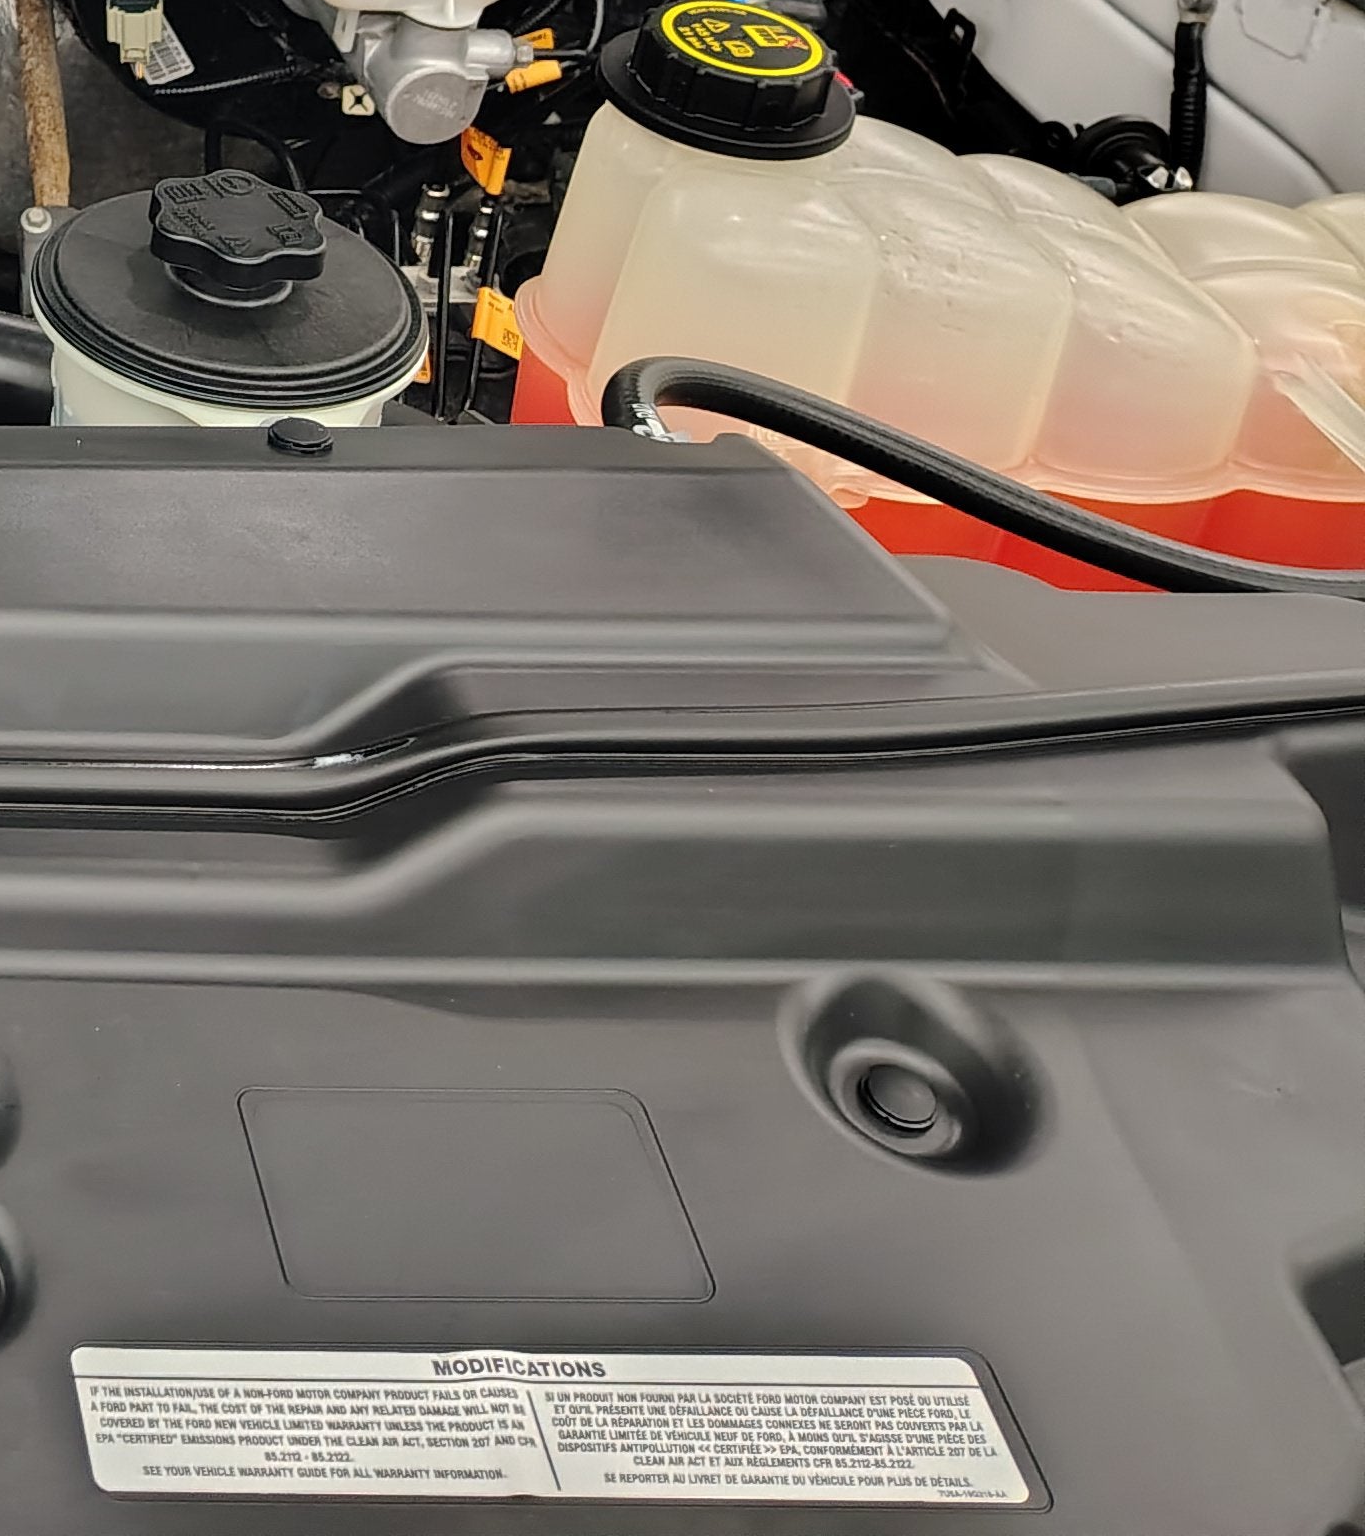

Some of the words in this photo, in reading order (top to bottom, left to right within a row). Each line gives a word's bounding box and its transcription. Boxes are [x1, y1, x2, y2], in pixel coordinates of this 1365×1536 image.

[432, 1358, 607, 1378] MODIFICATIONS
[102, 1385, 122, 1397] THE
[123, 1386, 215, 1398] INSTALLATION/USE
[242, 1388, 293, 1398] NON-FORD
[295, 1388, 331, 1399] MOTOR
[333, 1389, 381, 1400] COMPANY
[383, 1389, 429, 1400] PRODUCT
[432, 1390, 460, 1400] FAILS
[480, 1387, 518, 1398] CAUSES
[557, 1392, 570, 1402] UN
[573, 1392, 613, 1402] PRODUIT
[617, 1392, 637, 1402] NON
[639, 1392, 675, 1402] FOURNI
[677, 1393, 696, 1403] PAR
[698, 1393, 711, 1403] LA
[713, 1393, 753, 1404] SOCIÉTÉ
[756, 1393, 781, 1404] FORD
[784, 1394, 818, 1404] MOTOR
[820, 1395, 866, 1404] COMPANY
[869, 1395, 887, 1405] EST
[890, 1395, 915, 1405] POSÉ
[917, 1395, 931, 1406] OU
[933, 1396, 969, 1406] UTILISÉ
[99, 1401, 127, 1412] FORD
[129, 1402, 154, 1412] PART
[200, 1402, 219, 1414] THE
[221, 1403, 247, 1414] COST
[249, 1403, 263, 1414] OF
[266, 1403, 285, 1414] THE
[287, 1404, 323, 1414] REPAIR
[325, 1405, 347, 1414] AND
[349, 1405, 369, 1415] ANY
[372, 1404, 416, 1416] RELATED
[418, 1405, 461, 1416] DAMAGE
[463, 1405, 488, 1415] WILL
[490, 1403, 510, 1414] NOT
[553, 1406, 566, 1414] ET
[595, 1406, 645, 1415] PRÉSENTE
[647, 1406, 666, 1415] UNE
[669, 1406, 733, 1416] DÉFAILLANCE
[735, 1407, 748, 1416] OU
[751, 1407, 782, 1416] CAUSE
[784, 1407, 798, 1416] LA
[800, 1408, 864, 1417] DÉFAILLANCE
[898, 1409, 925, 1418] PIÈCE
[928, 1409, 956, 1418] FORD,
[99, 1417, 145, 1428] COVERED
[147, 1418, 160, 1428] BY
[163, 1418, 183, 1429] THE
[185, 1418, 212, 1429] FORD
[214, 1419, 237, 1429] NEW
[239, 1419, 280, 1430] VEHICLE
[283, 1419, 323, 1430] LIMITED
[326, 1420, 382, 1430] WARRANTY
[384, 1420, 423, 1431] UNLESS
[426, 1421, 446, 1432] THE
[447, 1420, 495, 1432] PRODUCT
[511, 1420, 525, 1430] AN
[551, 1417, 577, 1427] COÛT
[580, 1417, 593, 1427] DE
[595, 1418, 608, 1427] LA
[610, 1418, 670, 1428] RÉPARATION
[672, 1418, 684, 1428] ET
[687, 1419, 705, 1428] LES
[707, 1419, 763, 1428] DOMMAGES
[765, 1420, 816, 1429] CONNEXES
[818, 1420, 831, 1430] NE
[834, 1420, 871, 1430] SERONT
[874, 1421, 894, 1430] PAS
[896, 1421, 946, 1430] COUVERTS
[948, 1422, 968, 1431] PAR
[969, 1422, 984, 1431] LA
[95, 1433, 115, 1444] EPA
[180, 1434, 235, 1444] EMISSIONS
[238, 1435, 283, 1446] PRODUCT
[287, 1435, 321, 1446] UNDER
[324, 1436, 343, 1446] THE
[346, 1436, 379, 1446] CLEAN
[381, 1437, 399, 1446] AIR
[402, 1436, 424, 1448] ACT,
[426, 1437, 469, 1447] SECTION
[471, 1436, 491, 1448] 207
[494, 1435, 515, 1446] AND
[557, 1430, 607, 1440] GARANTIE
[609, 1430, 647, 1440] LIMITÉE
[650, 1431, 663, 1440] DE
[665, 1431, 711, 1441] VÉHICULE
[713, 1432, 738, 1441] NEUF
[741, 1432, 754, 1441] DE
[756, 1432, 785, 1442] FORD,
[797, 1432, 829, 1442] MOINS
[937, 1434, 965, 1444] PIÈCE
[967, 1434, 987, 1444] DES
[557, 1442, 617, 1452] DISPOSITIFS
[619, 1443, 695, 1453] ANTIPOLLUTION
[713, 1444, 761, 1454] CERTIFIÉE
[779, 1445, 800, 1454] EPA,
[803, 1445, 883, 1455] CONFORMÉMENT
[947, 1447, 965, 1457] 207
[968, 1447, 982, 1458] DE
[983, 1447, 999, 1458] LA
[633, 1456, 665, 1466] CLEAN
[668, 1456, 684, 1466] AIR
[687, 1456, 705, 1466] ACT
[709, 1456, 721, 1467] ET
[724, 1457, 743, 1466] AUX
[746, 1457, 810, 1468] RÈGLEMENTS
[142, 1465, 162, 1476] SEE
[165, 1466, 191, 1476] YOUR
[193, 1466, 235, 1476] VEHICLE
[238, 1467, 294, 1477] WARRANTY
[297, 1468, 327, 1477] GUIDE
[329, 1467, 350, 1478] FOR
[353, 1468, 372, 1478] ALL
[373, 1468, 430, 1478] WARRANTY
[433, 1469, 511, 1479] INFORMATION.
[603, 1472, 617, 1483] SE
[619, 1473, 669, 1483] REPORTER
[672, 1473, 685, 1483] AU
[688, 1473, 721, 1484] LIVRET
[725, 1474, 737, 1484] DE
[741, 1475, 789, 1484] GARANTIE
[792, 1475, 806, 1485] DU
[808, 1475, 855, 1486] VÉHICULE
[858, 1476, 884, 1486] POUR
[887, 1476, 912, 1486] PLUS
[914, 1476, 927, 1486] DE
